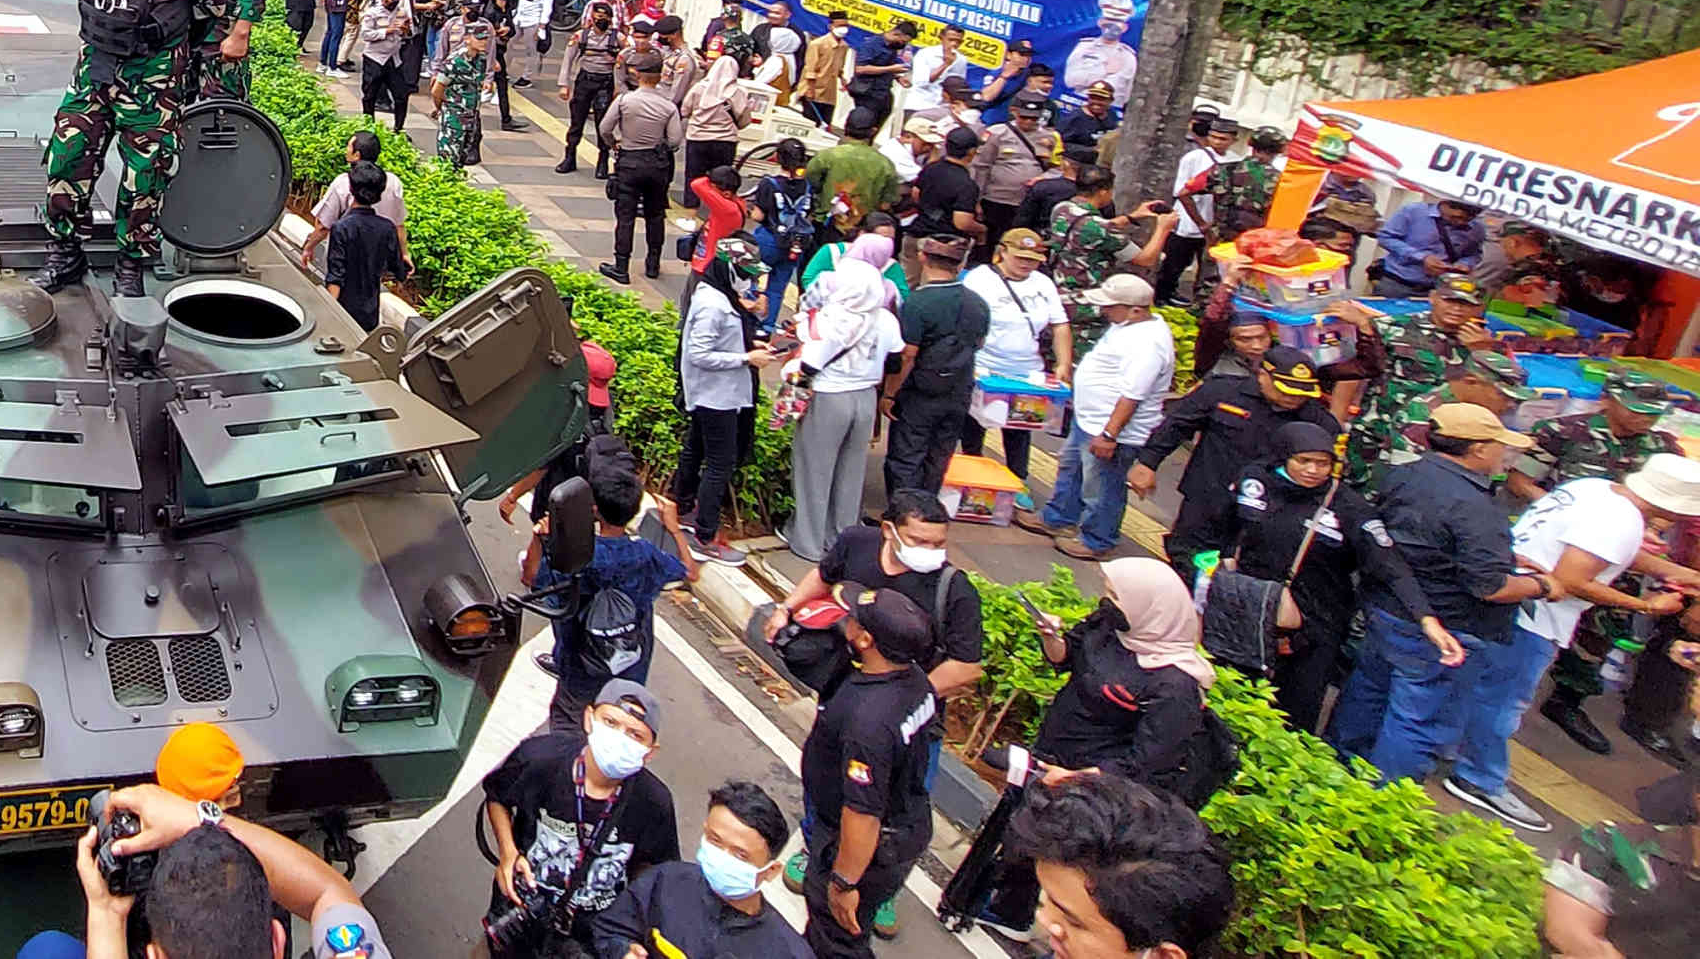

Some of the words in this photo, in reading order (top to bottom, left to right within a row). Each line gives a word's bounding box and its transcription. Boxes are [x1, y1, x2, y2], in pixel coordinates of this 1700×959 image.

[957, 7, 1012, 37] PRESISI
[963, 36, 999, 56] 2022
[1460, 183, 1549, 225] POLDA
[1560, 210, 1664, 258] METRO
[1, 797, 90, 831] 9579-0
